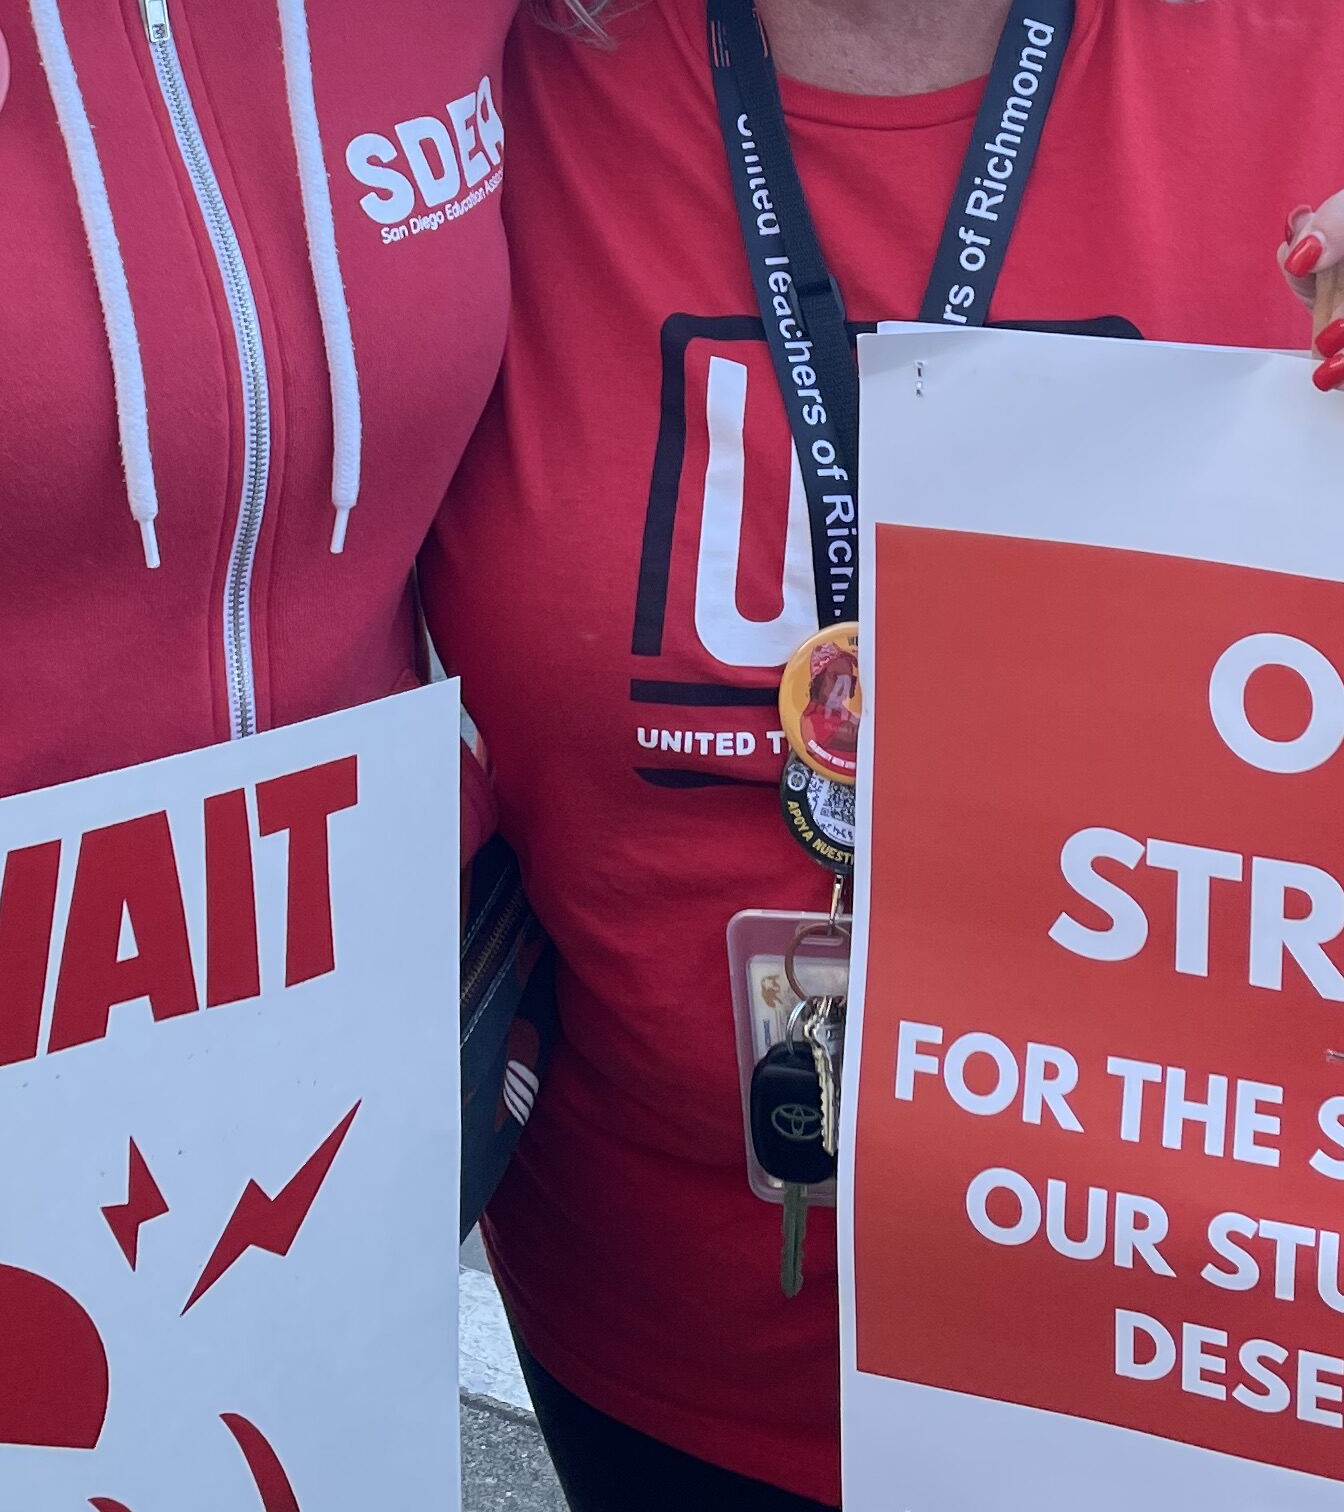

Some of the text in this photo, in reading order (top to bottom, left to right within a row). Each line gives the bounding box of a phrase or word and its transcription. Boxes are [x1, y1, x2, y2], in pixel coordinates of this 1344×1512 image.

[345, 75, 505, 224] SDEA
[965, 18, 1055, 221] Richmond
[381, 225, 409, 245] San
[409, 210, 445, 234] Diego
[958, 226, 991, 272] of
[811, 439, 848, 481] of
[637, 727, 756, 757] UNITED
[894, 1020, 1084, 1133] FOR
[1106, 1056, 1283, 1168] THE
[965, 1166, 1176, 1279] OUR
